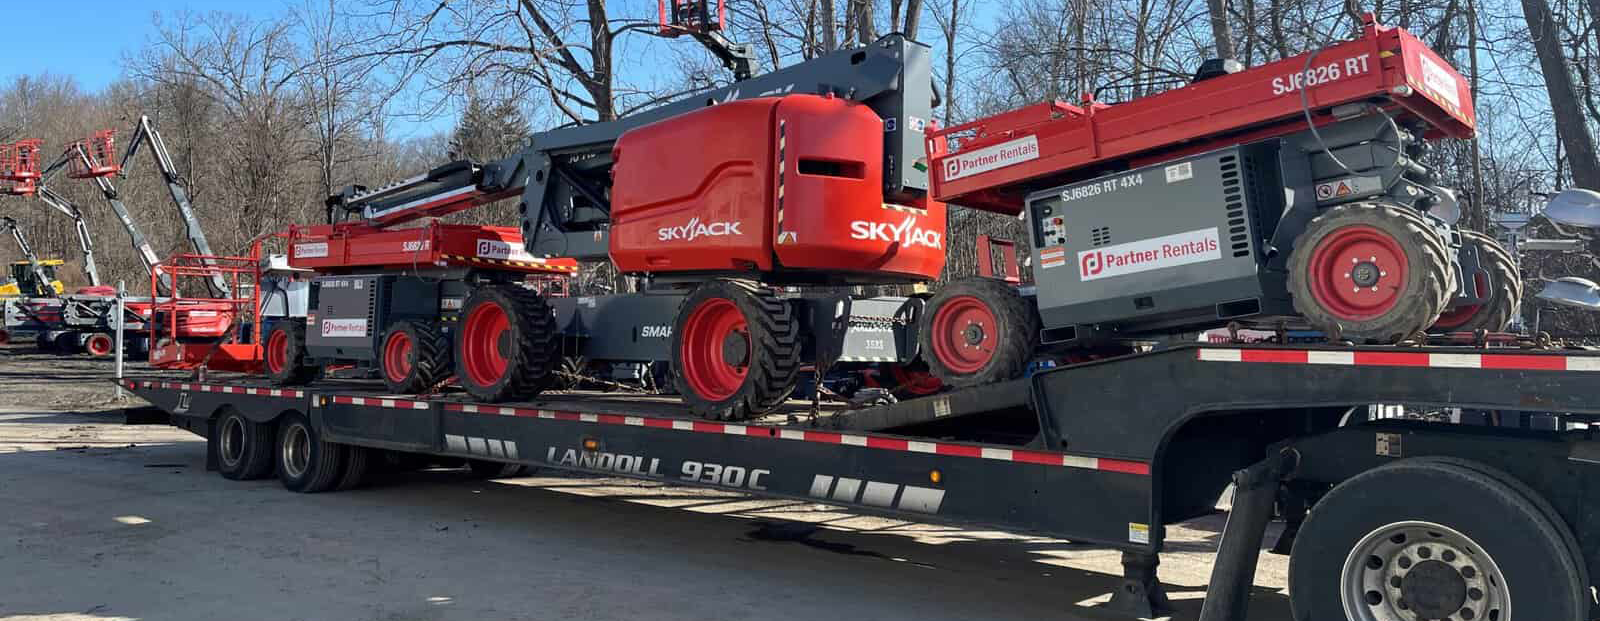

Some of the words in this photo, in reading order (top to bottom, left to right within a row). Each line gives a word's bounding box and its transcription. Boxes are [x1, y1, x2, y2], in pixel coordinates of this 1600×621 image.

[1271, 62, 1341, 96] SJ6826
[1344, 54, 1370, 77] RT
[962, 153, 999, 171] Partner
[1000, 142, 1038, 160] Rentals
[1062, 184, 1102, 203] SJ6826
[1103, 178, 1119, 194] RT
[1120, 173, 1143, 188] 4X4
[657, 217, 743, 241] SKYJACK
[850, 217, 942, 249] SKYJACK
[1106, 245, 1159, 269] Partner
[1161, 237, 1218, 261] Rentals
[546, 446, 665, 478] LANDOLL
